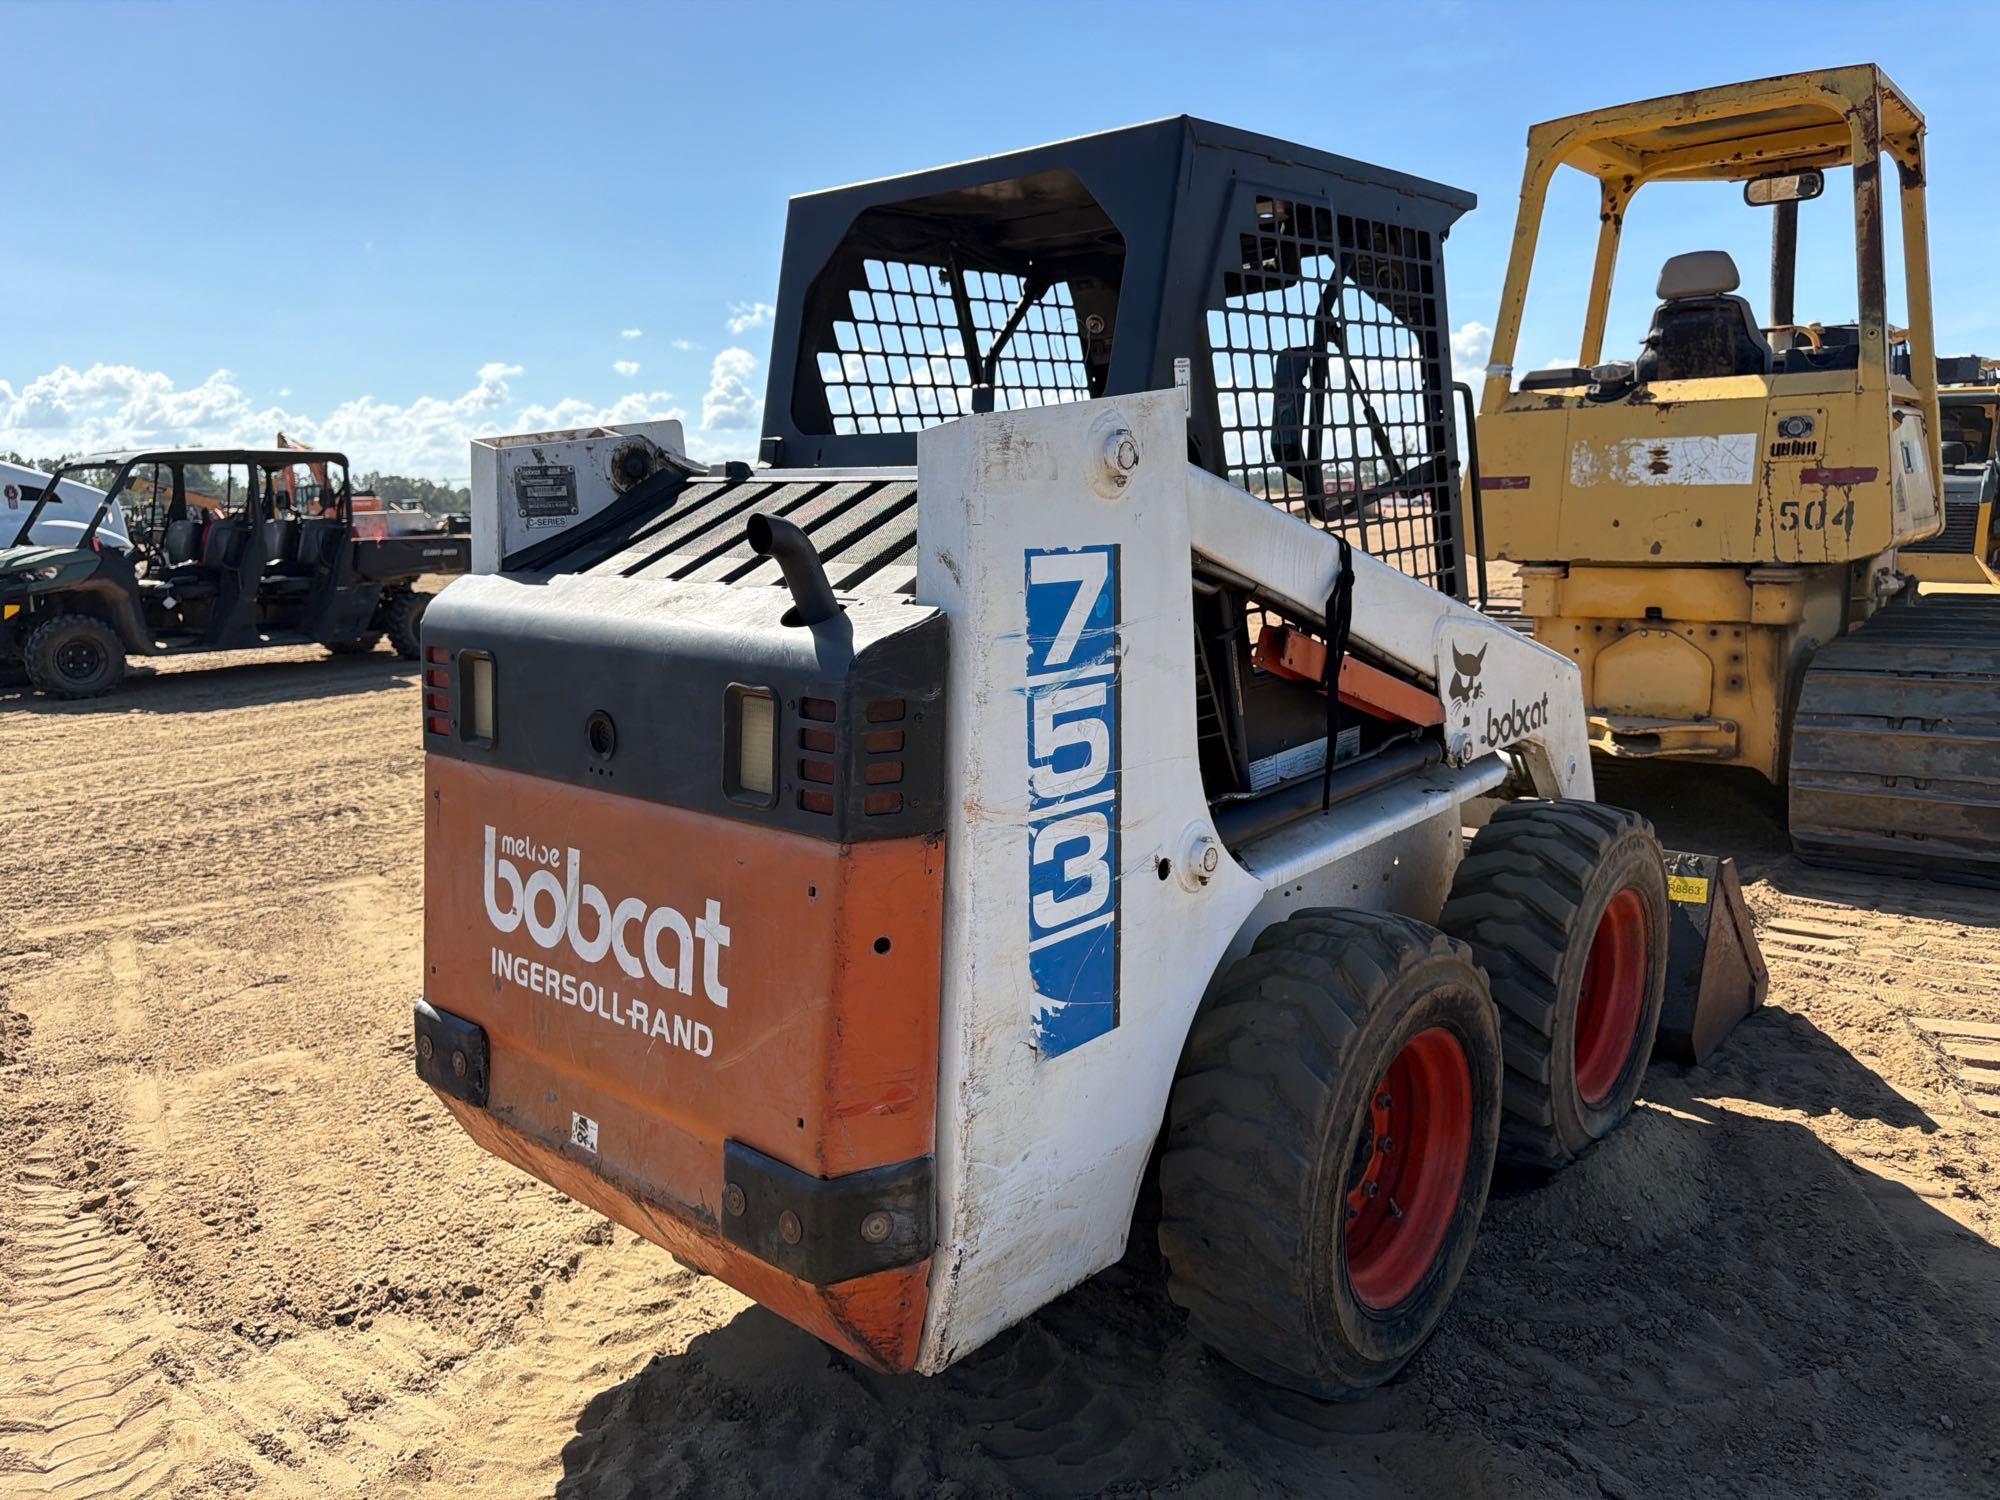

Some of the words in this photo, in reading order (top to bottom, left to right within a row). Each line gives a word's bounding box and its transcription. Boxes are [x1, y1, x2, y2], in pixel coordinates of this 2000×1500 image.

[528, 517, 566, 527] C-SERIES
[1780, 501, 1854, 534] 504
[1031, 550, 1110, 930] 753
[1487, 691, 1548, 748] bobcat
[484, 824, 731, 1009] bobcat
[491, 947, 714, 1058] INGERSOLL-RAND
